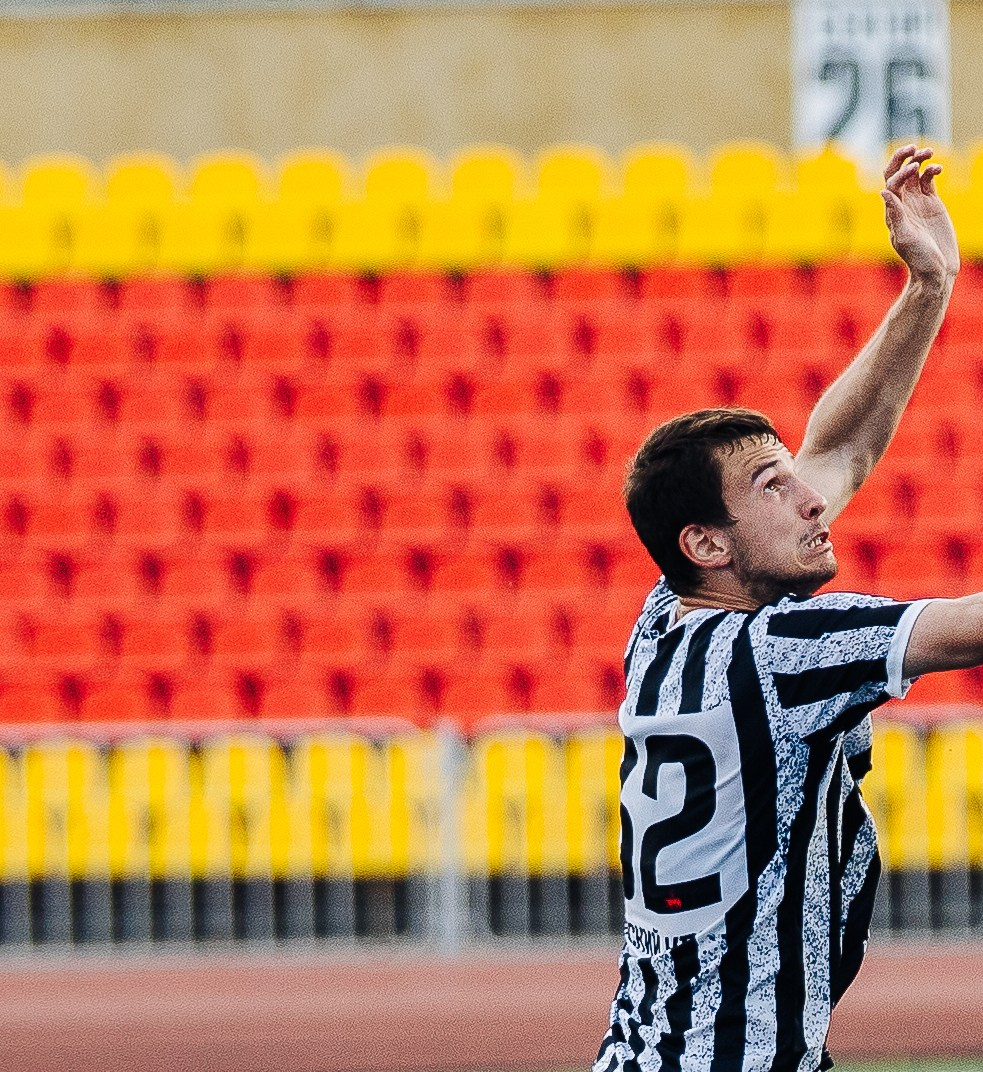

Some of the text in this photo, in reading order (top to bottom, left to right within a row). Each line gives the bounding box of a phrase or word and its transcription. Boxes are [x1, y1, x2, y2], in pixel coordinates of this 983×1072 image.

[815, 52, 932, 140] 26
[620, 734, 723, 915] 2
[624, 922, 661, 957] СКИЙ
